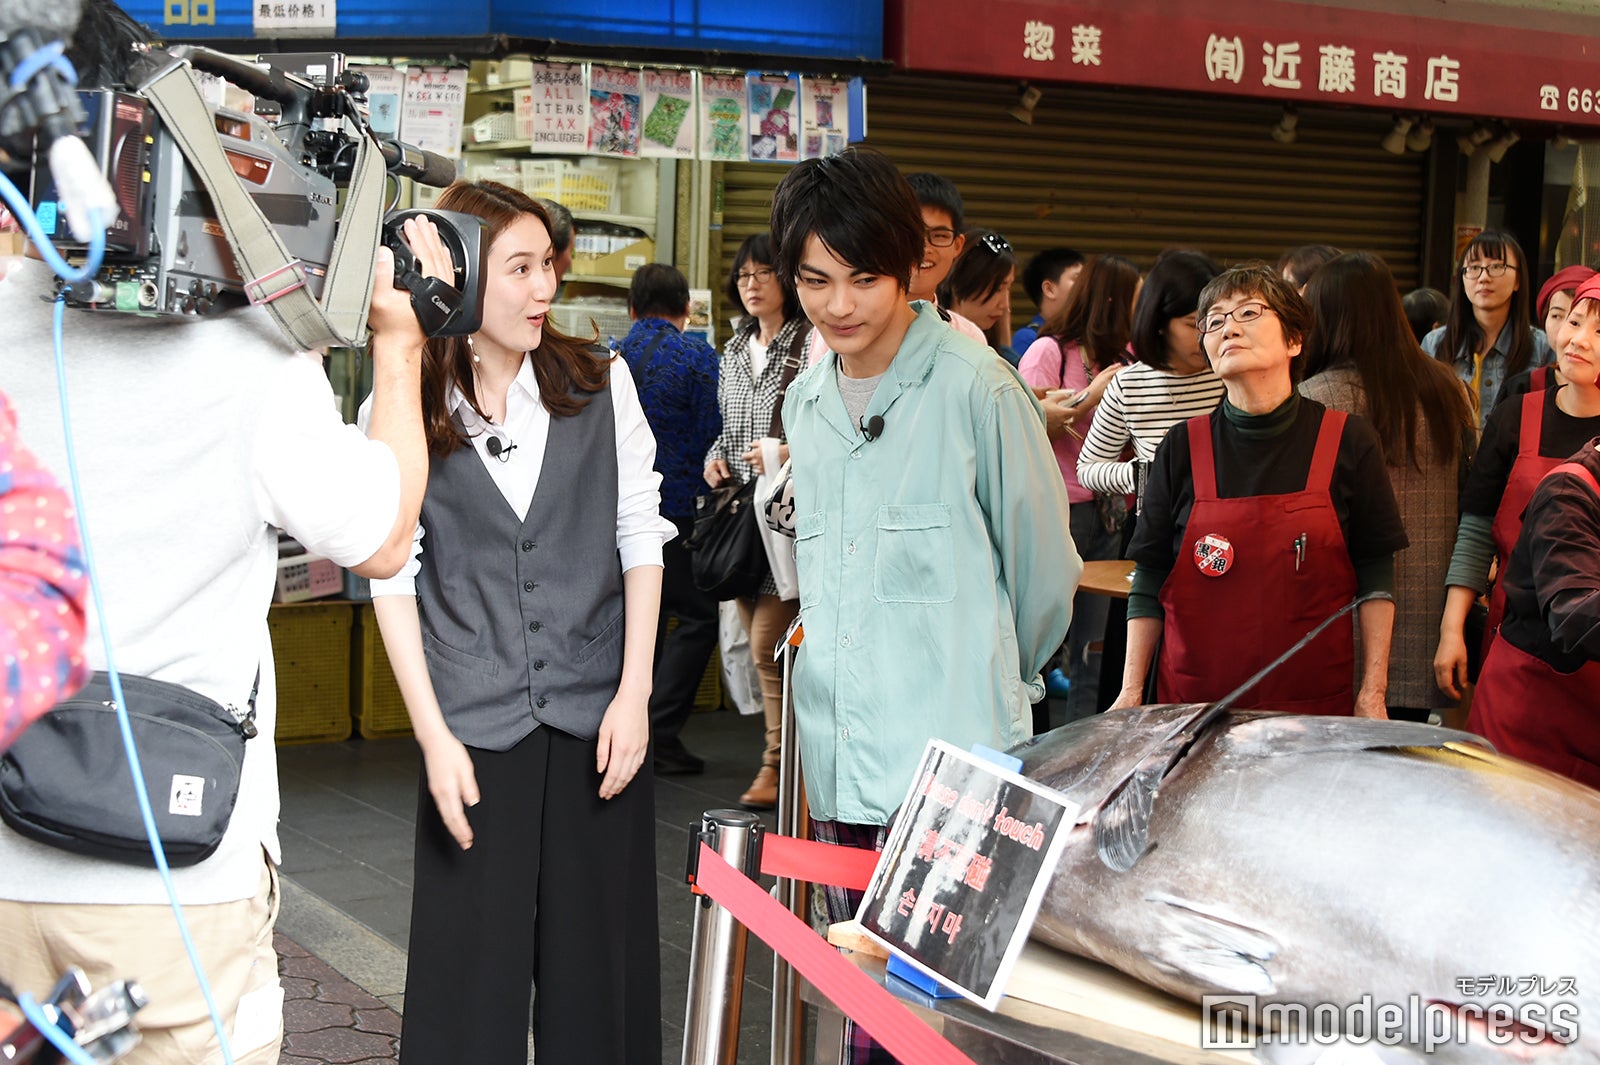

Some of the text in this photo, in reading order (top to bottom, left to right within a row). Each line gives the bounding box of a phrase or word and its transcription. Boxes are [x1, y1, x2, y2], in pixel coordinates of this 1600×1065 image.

[1022, 20, 1103, 66] 惣菜
[545, 87, 574, 100] ALL
[535, 103, 584, 115] ITEMS
[545, 118, 576, 130] TAX
[534, 132, 585, 143] INCLUDED
[993, 806, 1045, 852] touch
[897, 887, 946, 934] 손지
